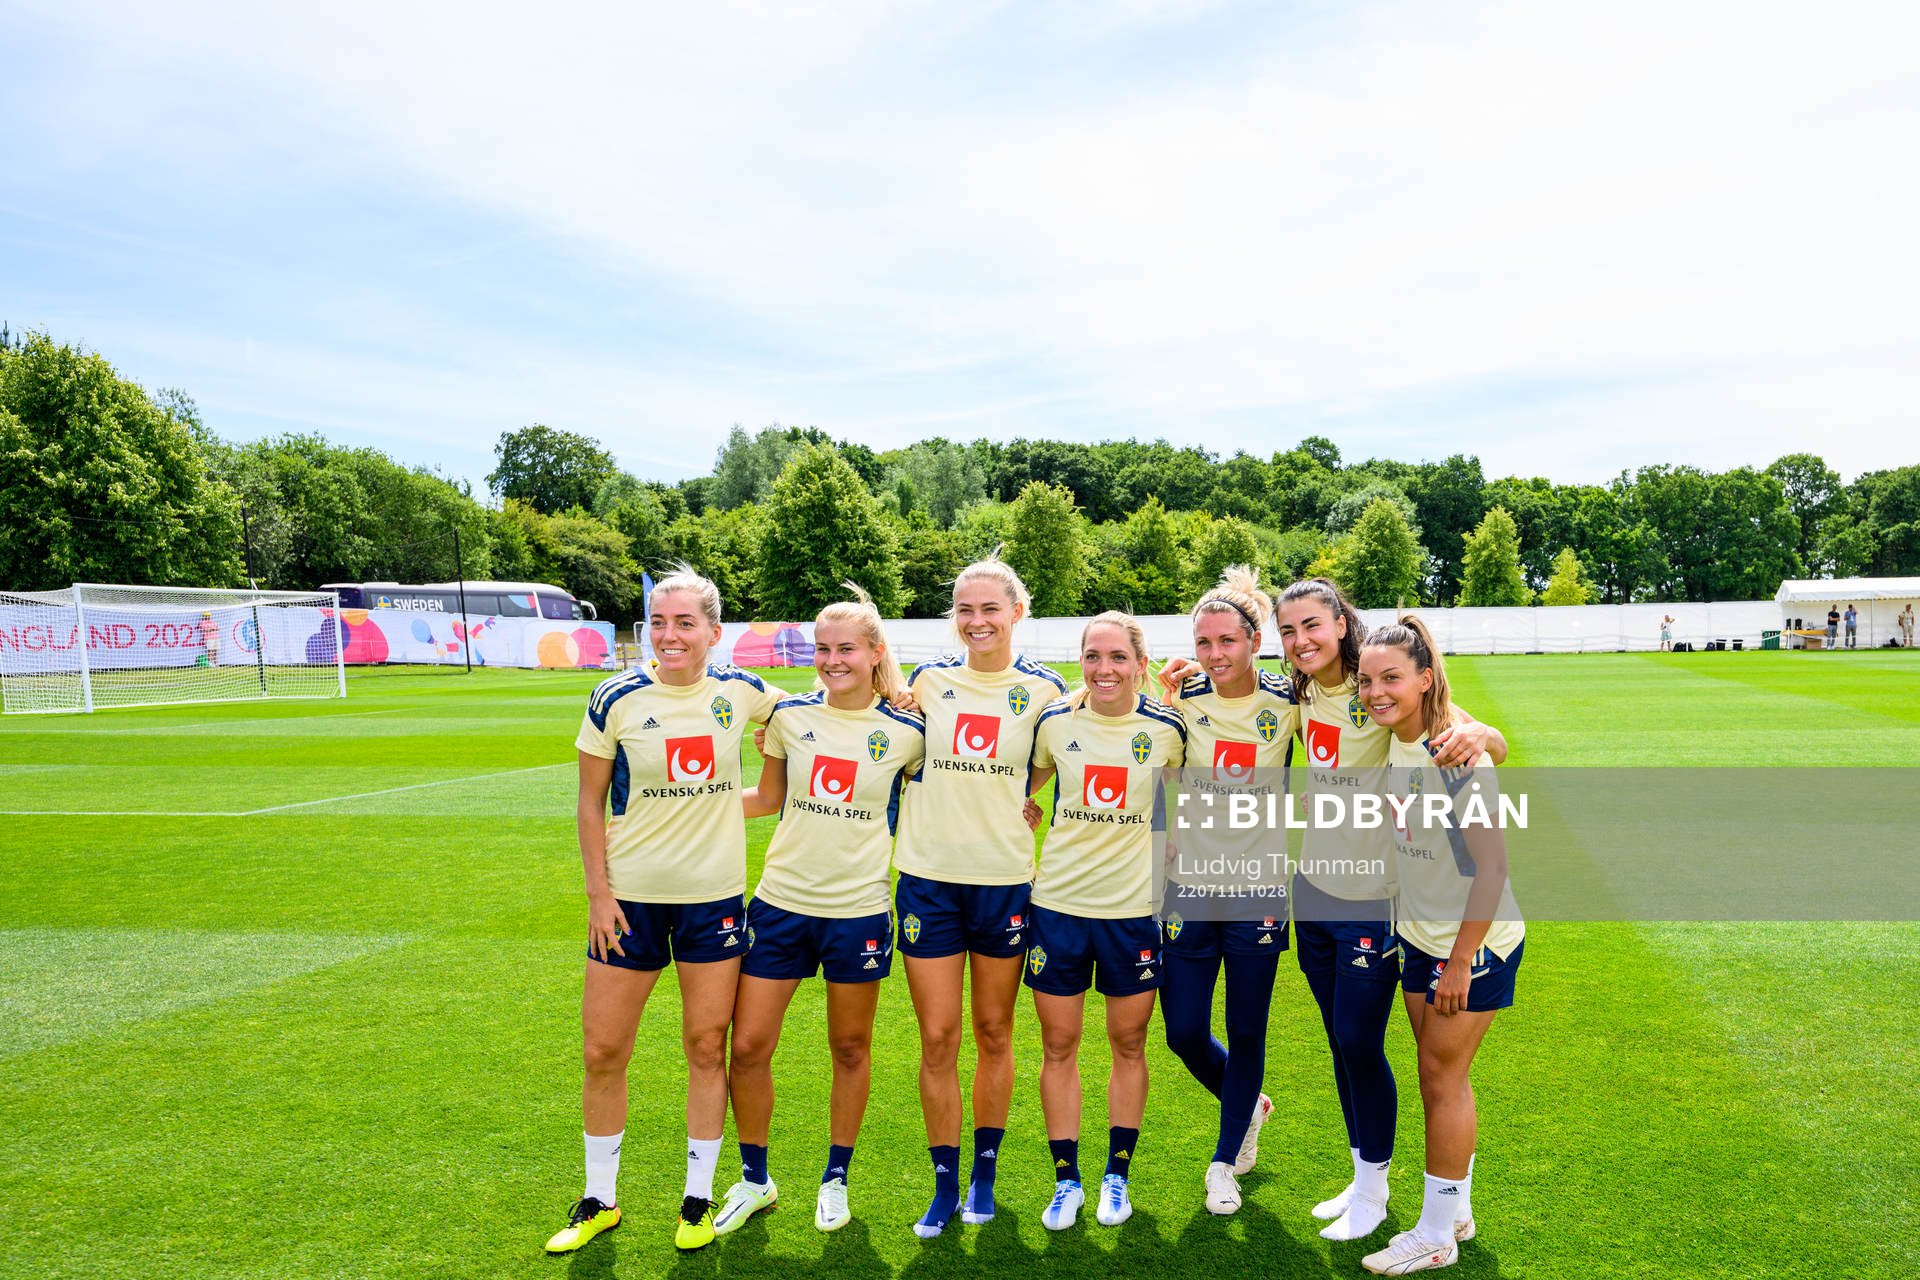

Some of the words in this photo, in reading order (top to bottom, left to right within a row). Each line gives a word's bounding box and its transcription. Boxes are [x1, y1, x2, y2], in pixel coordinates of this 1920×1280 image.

[393, 599, 444, 612] SWEDEN
[932, 759, 986, 774] SVENSKA
[990, 764, 1015, 776] SPEL
[642, 787, 703, 798] SVENSKA
[708, 781, 733, 794] SPEL
[1192, 778, 1243, 795] SVENSKA
[1248, 785, 1273, 796] SPEL
[1331, 776, 1360, 787] SPEL
[792, 798, 841, 817] SVENSKA
[845, 808, 872, 820] SPEL
[1063, 808, 1114, 823] SVENSKA
[1118, 814, 1145, 824] SPEL
[1409, 847, 1436, 860] SPEL
